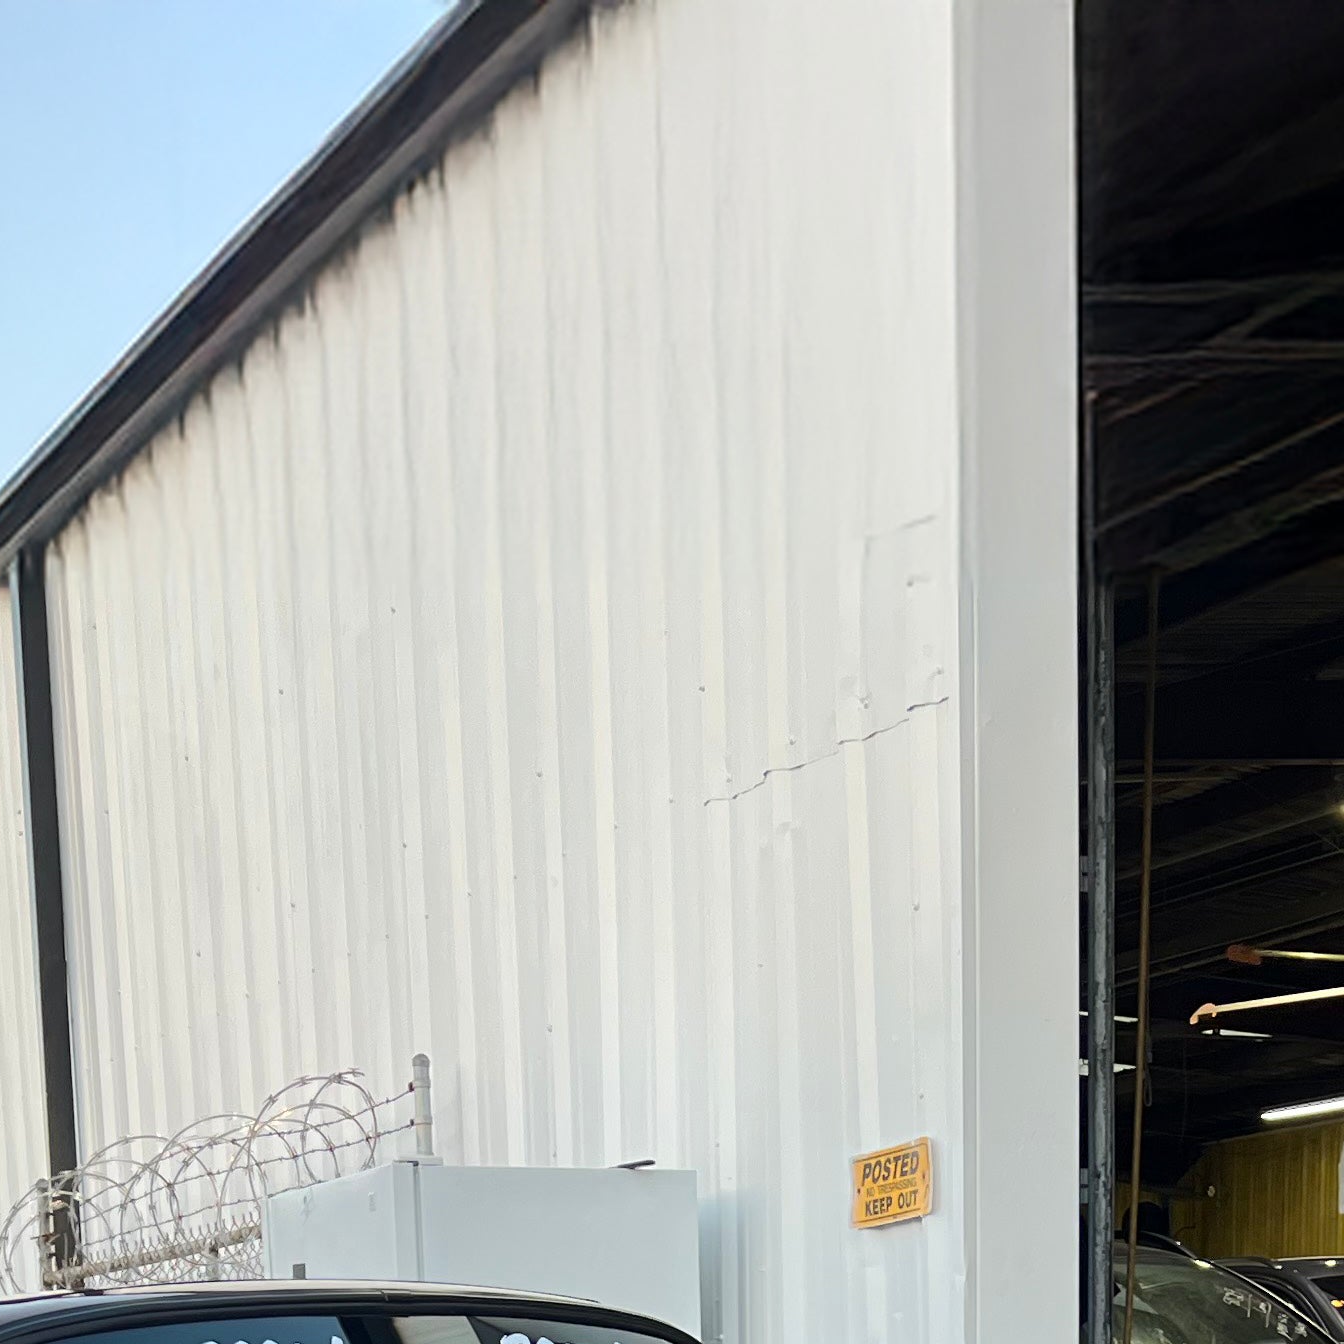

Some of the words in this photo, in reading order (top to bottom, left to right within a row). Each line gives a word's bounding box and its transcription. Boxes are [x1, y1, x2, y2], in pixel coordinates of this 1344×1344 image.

[862, 1151, 919, 1186] POSTED
[865, 1196, 893, 1217] KEEP
[898, 1189, 919, 1209] OUT
